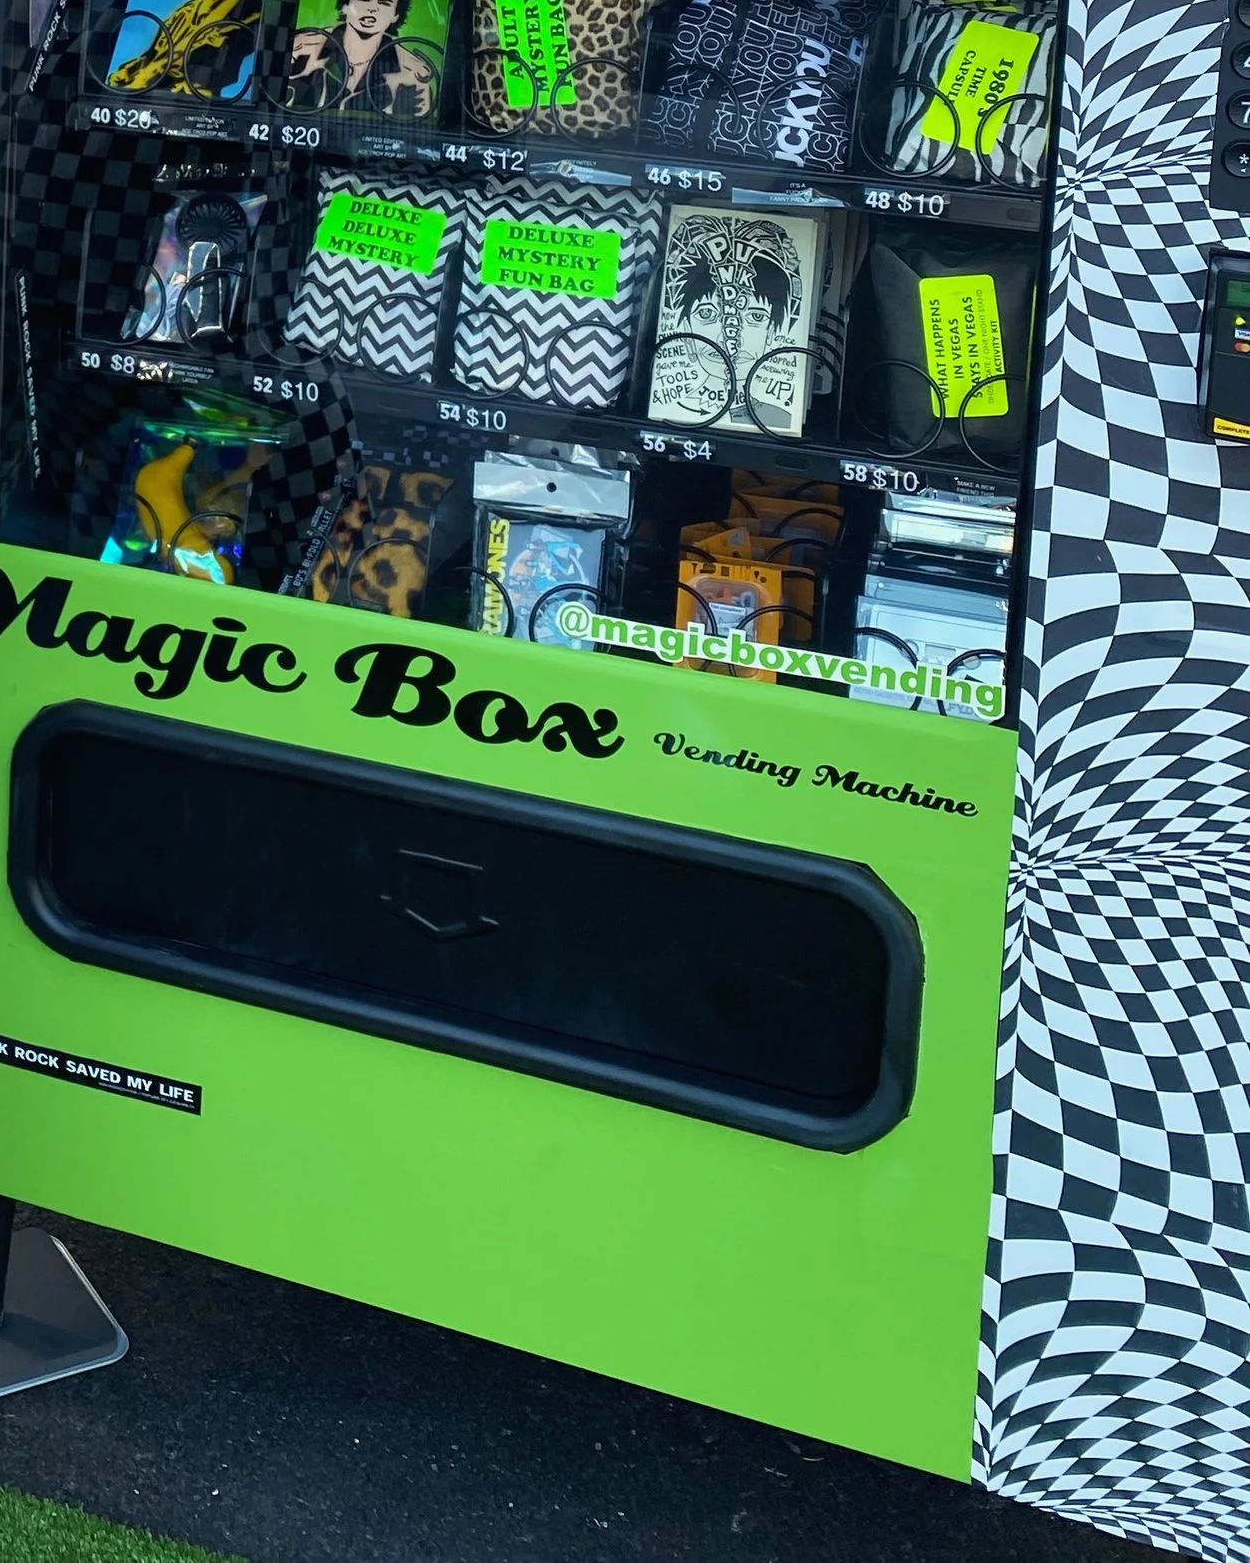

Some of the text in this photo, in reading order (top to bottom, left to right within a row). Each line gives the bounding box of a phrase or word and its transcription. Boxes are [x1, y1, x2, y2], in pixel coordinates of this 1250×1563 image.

[29, 53, 45, 92] PUNK
[43, 12, 61, 51] ROCK
[966, 67, 986, 98] TIME
[90, 107, 111, 123] 40
[249, 124, 269, 141] 42
[282, 127, 321, 148] $20
[446, 145, 467, 162] 44
[482, 149, 524, 171] $12
[648, 168, 671, 185] 46
[678, 170, 722, 191] $15
[866, 192, 890, 208] 48
[898, 192, 944, 215] $10
[350, 200, 423, 226] DELUXE
[342, 219, 418, 247] DELUXE
[509, 226, 594, 249] DELUXE
[328, 235, 418, 268] MYSTERY
[498, 246, 601, 271] MYSTERY
[500, 268, 594, 293] FUN BAG
[660, 322, 676, 332] the
[963, 296, 980, 358] IN VEGAS
[656, 346, 686, 359] SCENE
[930, 299, 949, 400] WHAT HAPPENS
[948, 318, 963, 379] IN VEGAS
[990, 320, 1003, 372] ACTIVITY KIT
[655, 361, 677, 374] gave
[657, 370, 698, 385] TOOLS
[663, 385, 692, 404] HOPE
[699, 387, 725, 401] JOE
[769, 378, 794, 407] UP!
[82, 352, 100, 368] 50
[253, 377, 273, 393] 52
[280, 381, 318, 401] $10
[439, 403, 461, 421] 54
[467, 409, 507, 431] $10
[643, 436, 666, 452] 56
[684, 441, 712, 460] $4
[844, 464, 866, 482] 58
[873, 468, 918, 492] $10
[560, 605, 1002, 715] @magicboxvending
[335, 643, 625, 759] Box
[653, 731, 800, 787] Vending
[811, 764, 978, 816] Machine
[15, 1046, 59, 1069] ROCK
[66, 1060, 121, 1084] SAVED
[127, 1075, 152, 1092] MY
[159, 1084, 194, 1103] LIFE
